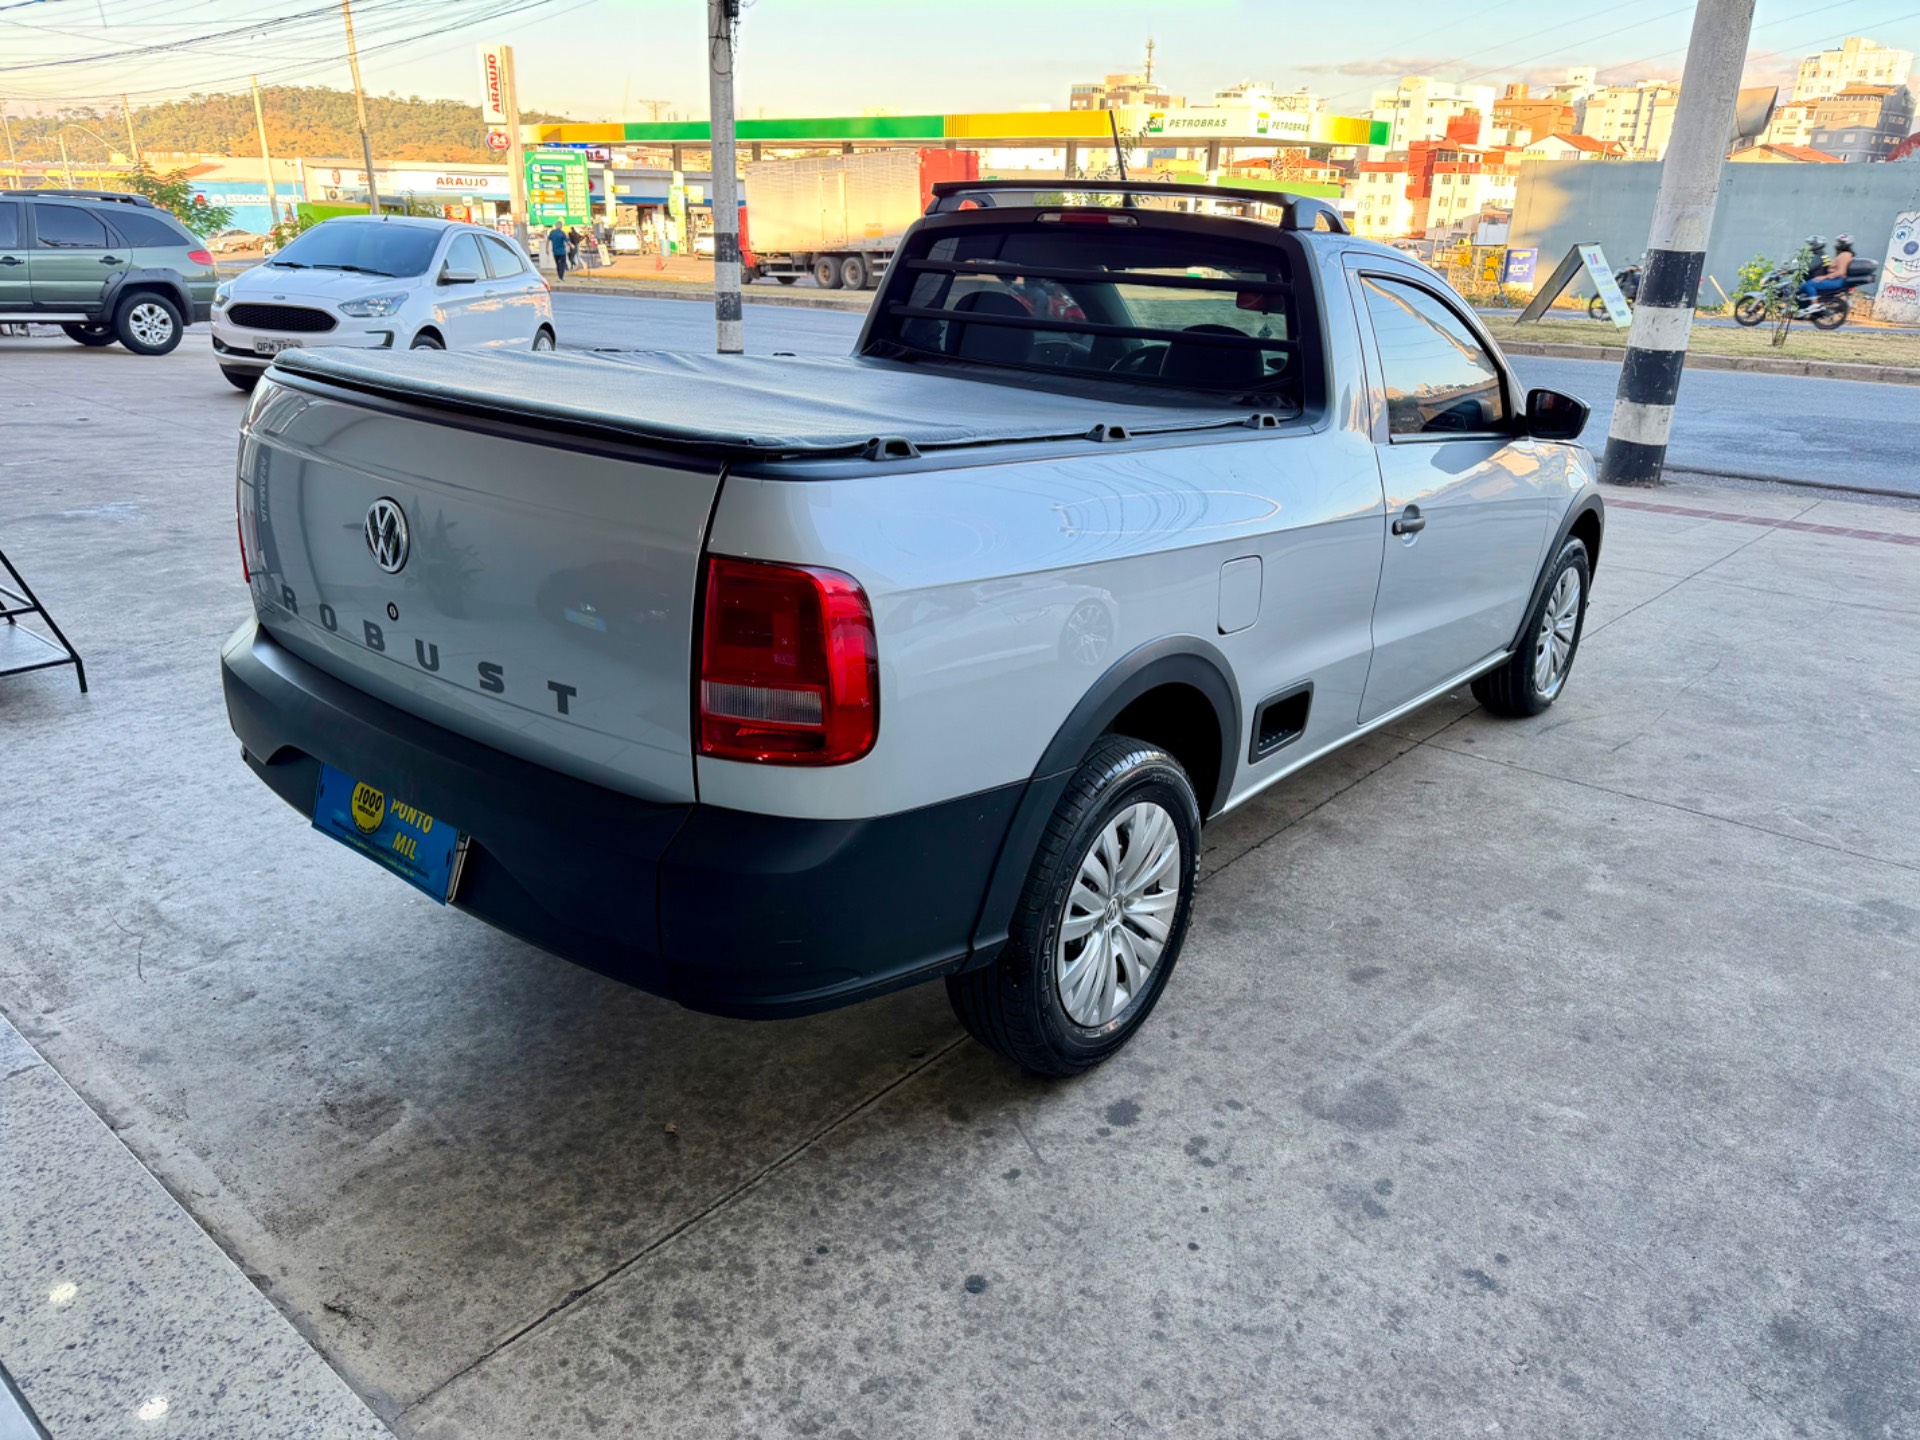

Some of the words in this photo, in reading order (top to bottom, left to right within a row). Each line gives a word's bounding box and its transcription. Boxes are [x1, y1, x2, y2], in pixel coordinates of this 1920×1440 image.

[487, 53, 501, 113] ARAUJO
[1168, 118, 1228, 128] PETROBRAS
[1271, 120, 1311, 133] PETROBRAS
[436, 176, 489, 187] ARAUJO
[280, 583, 578, 716] ROBUST
[392, 831, 418, 861] MIL
